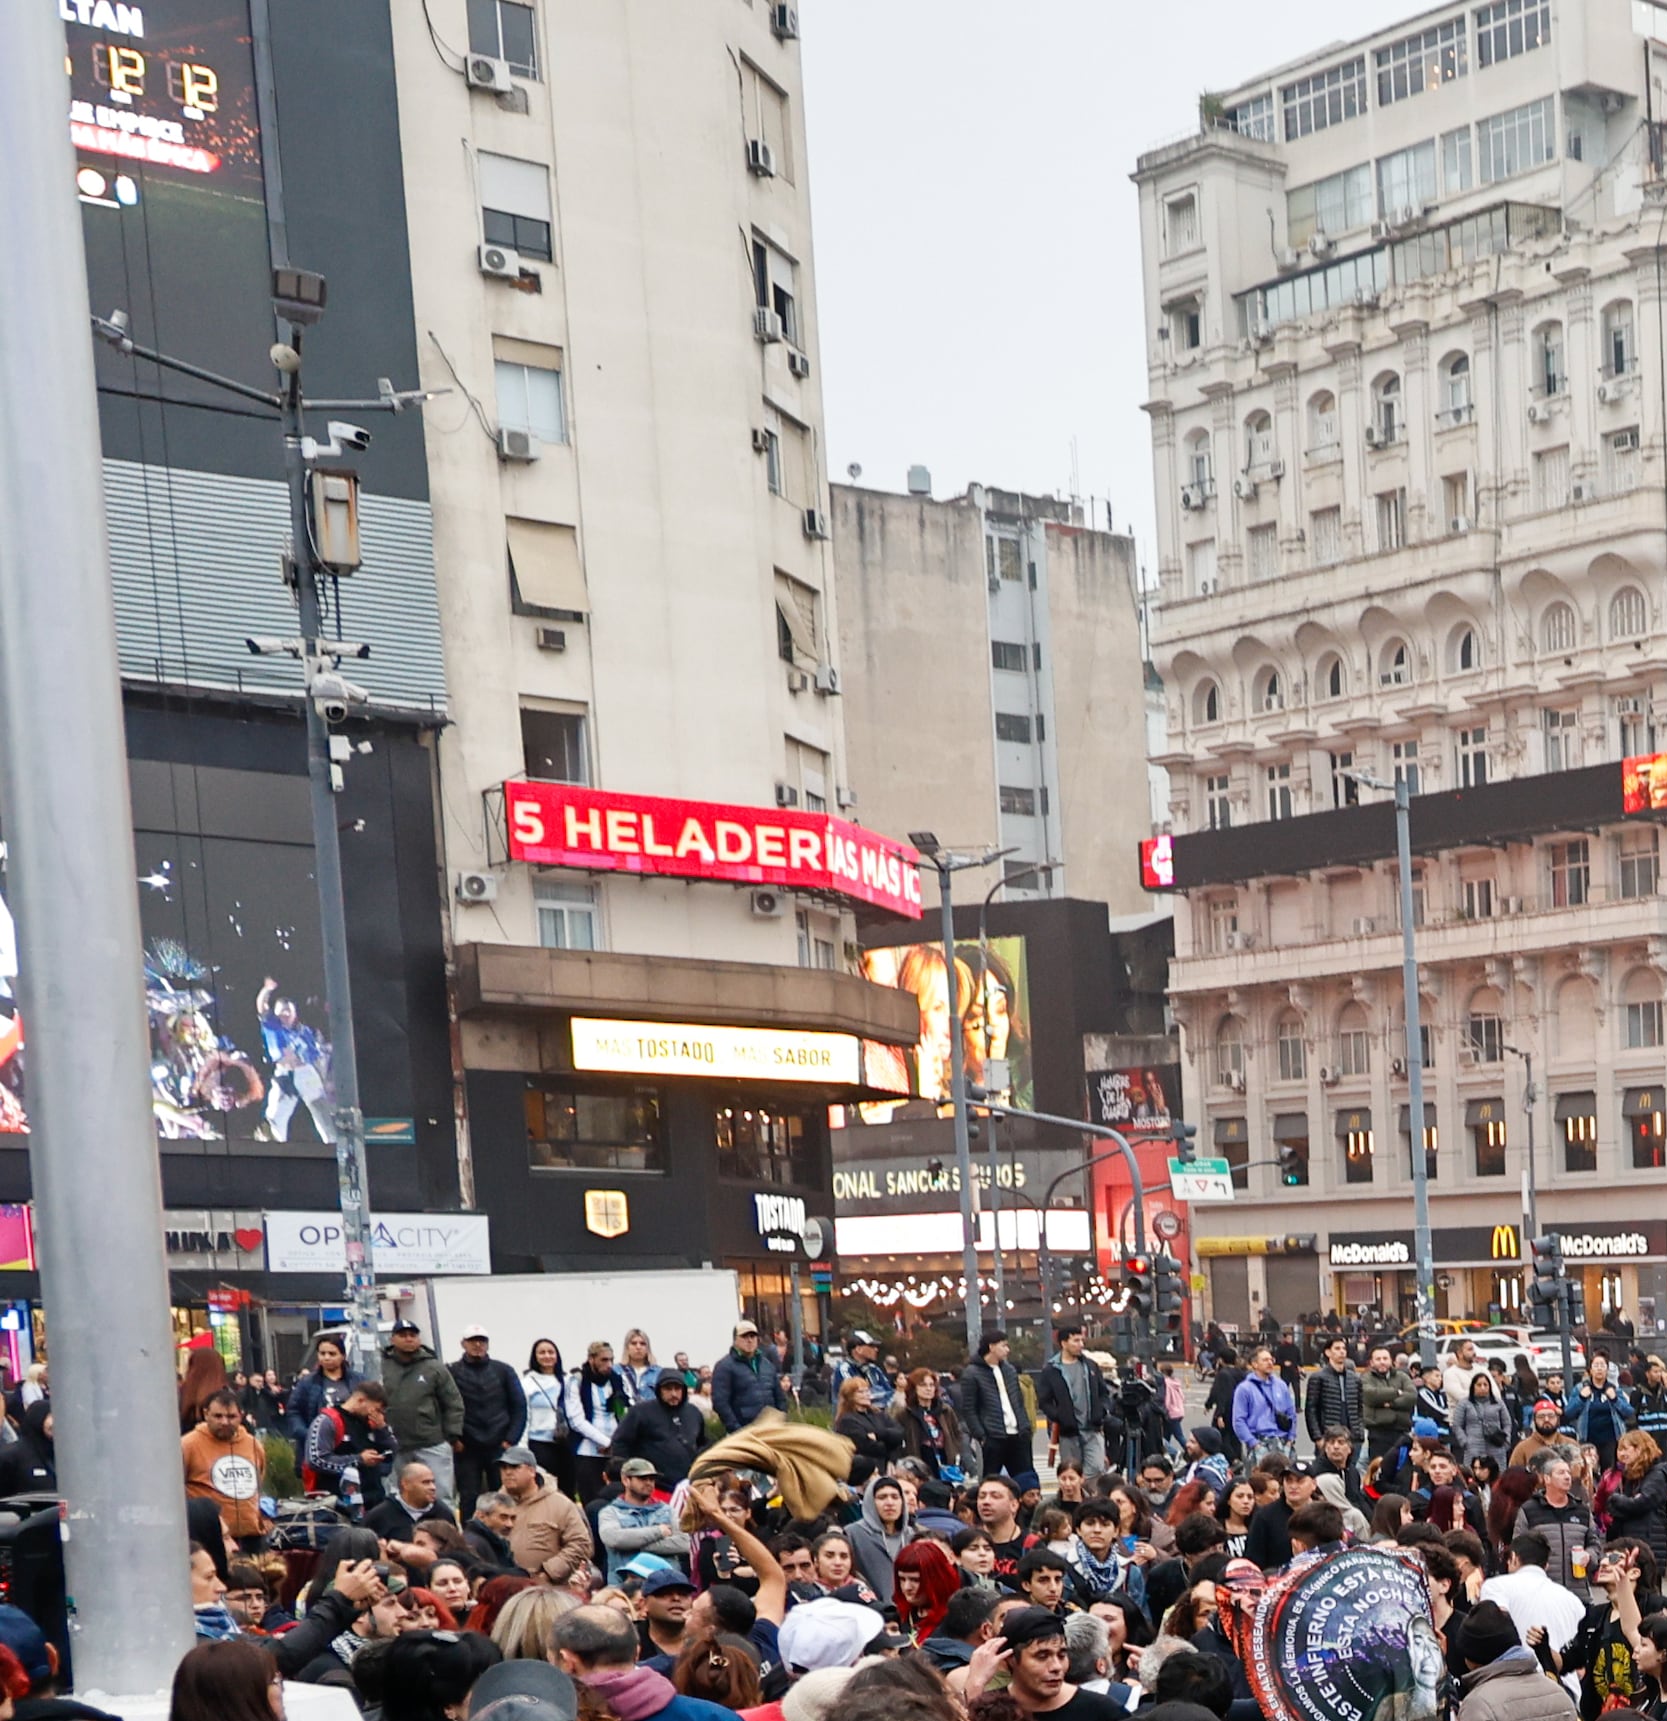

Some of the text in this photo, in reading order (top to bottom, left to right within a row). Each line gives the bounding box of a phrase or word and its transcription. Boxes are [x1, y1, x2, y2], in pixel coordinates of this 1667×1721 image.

[60, 0, 144, 38] LTAN
[514, 801, 545, 844] 5
[564, 805, 859, 881] HELADERÍAS
[862, 844, 900, 896] MÁS
[637, 1038, 715, 1064] TOSTADO
[773, 1047, 832, 1067] SABOR
[832, 1170, 881, 1199] ONAL
[754, 1193, 805, 1237] TOSTADO
[1331, 1241, 1409, 1264] McDonald's
[1560, 1234, 1648, 1256] McDonald's
[218, 1467, 252, 1479] VANS
[1292, 1600, 1305, 1615] ES
[1253, 1594, 1273, 1660] DESEANDO
[1337, 1585, 1415, 1660] ESTA NOCHE
[1255, 1662, 1273, 1696] ALTO
[1265, 1696, 1280, 1711] EN
